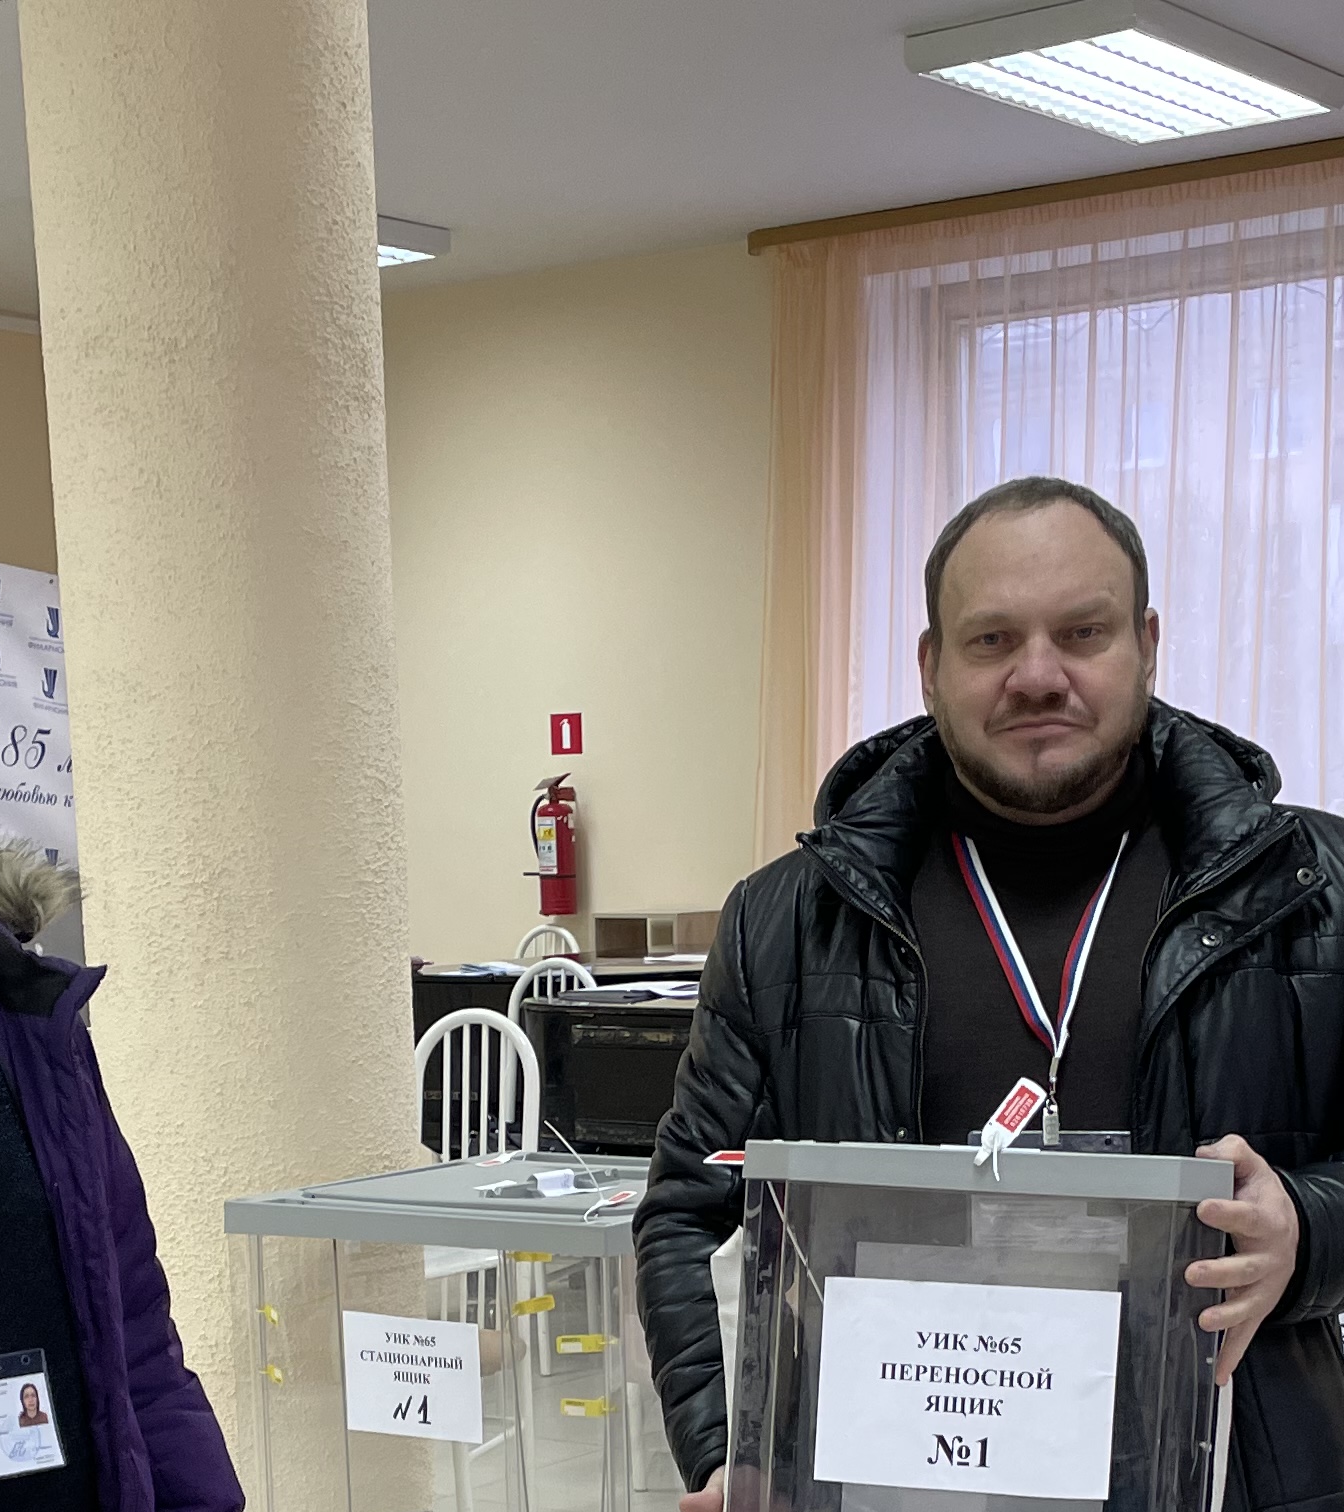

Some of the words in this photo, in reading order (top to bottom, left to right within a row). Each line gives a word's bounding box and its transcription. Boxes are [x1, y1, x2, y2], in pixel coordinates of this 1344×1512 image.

[385, 1331, 410, 1345] УИК
[412, 1334, 436, 1348] №65
[916, 1331, 968, 1351] УИК
[973, 1335, 1022, 1355] №65
[359, 1350, 463, 1371] СТАЦИОНАРНЫЙ
[393, 1370, 431, 1385] ЯЩИК
[879, 1362, 1053, 1390] ПЕРЕНОСНОЙ
[924, 1394, 1004, 1418] ЯЩИК
[926, 1433, 990, 1469] №1
